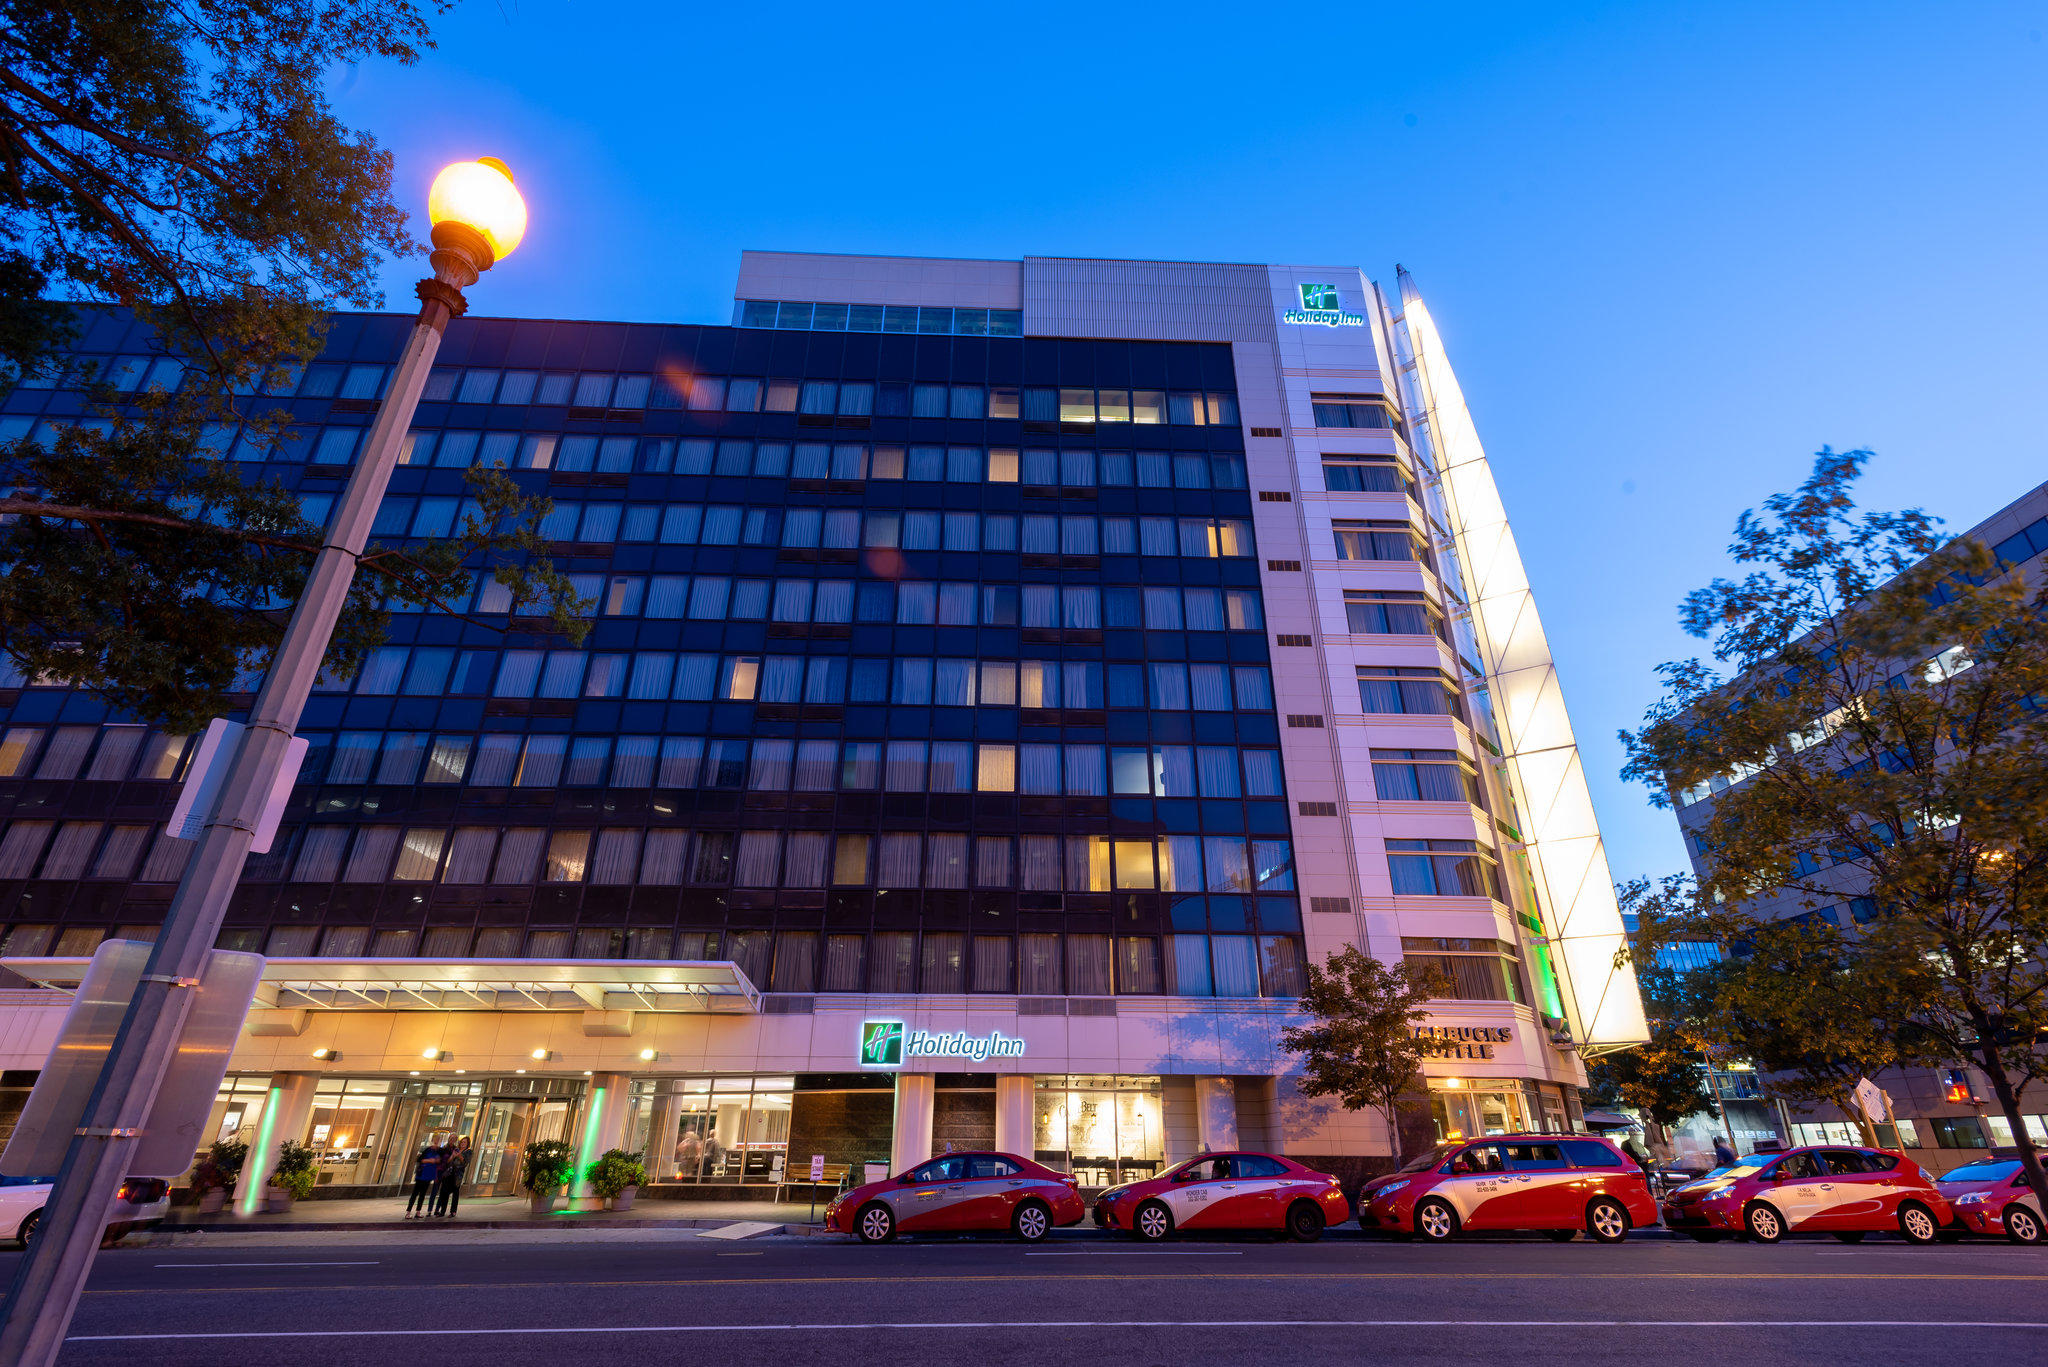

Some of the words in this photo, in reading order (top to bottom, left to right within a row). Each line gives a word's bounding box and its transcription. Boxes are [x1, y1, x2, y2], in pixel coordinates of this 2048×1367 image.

[1285, 309, 1339, 327] Holiday
[1340, 311, 1363, 325] Inn
[1406, 1026, 1514, 1042] TARBUCKS
[907, 1032, 989, 1060] Holiday
[990, 1032, 1024, 1055] Inn
